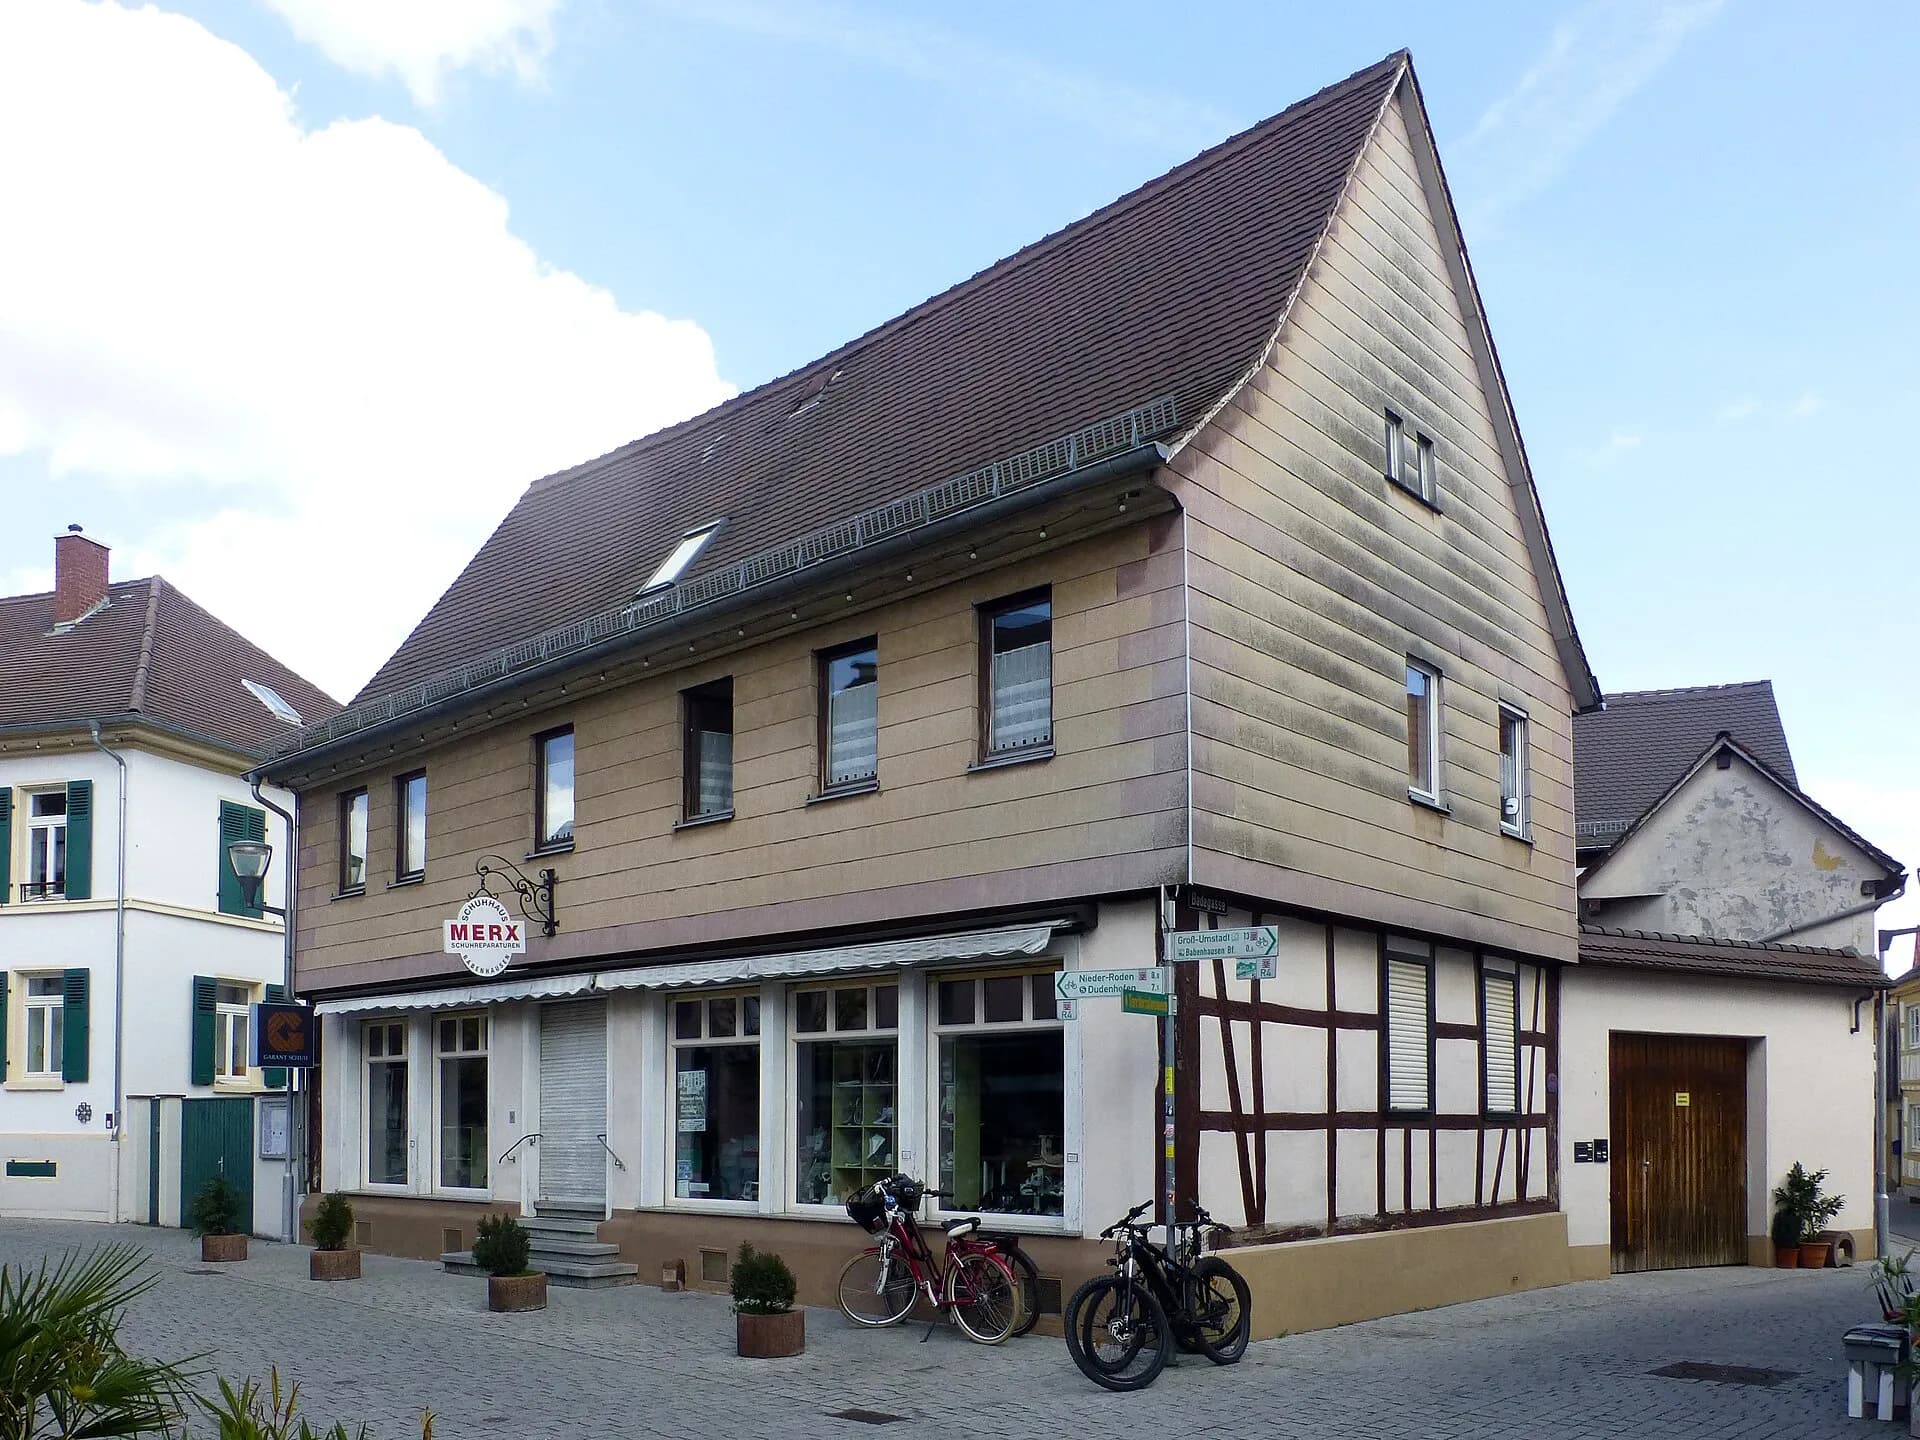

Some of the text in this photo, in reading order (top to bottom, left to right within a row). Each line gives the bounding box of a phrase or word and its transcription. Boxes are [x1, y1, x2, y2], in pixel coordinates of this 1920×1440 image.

[1191, 891, 1226, 911] Badegasse
[461, 899, 508, 922] SCHUHHAUS
[450, 924, 520, 941] MERX
[1177, 933, 1230, 945] Groß-Umstadt
[1185, 948, 1225, 957] Babenhausen
[462, 954, 510, 974] BABENHAUSEN
[1079, 972, 1135, 983] Nieder-Roden
[1260, 968, 1272, 977] R4
[1061, 1010, 1073, 1019] R4
